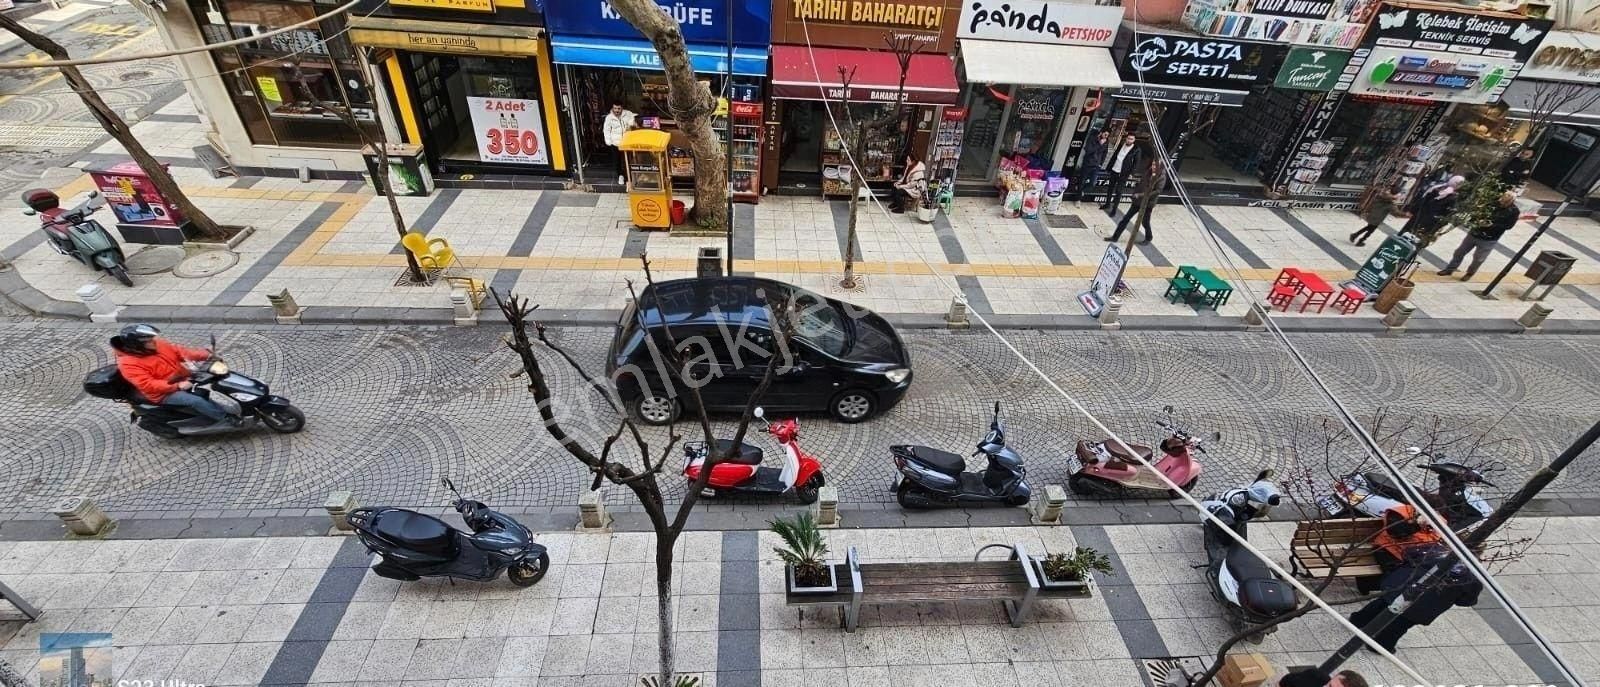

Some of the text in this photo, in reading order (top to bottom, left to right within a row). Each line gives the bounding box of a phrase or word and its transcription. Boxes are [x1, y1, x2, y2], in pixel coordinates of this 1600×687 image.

[852, 2, 942, 29] BAHARATÇI
[970, 2, 1112, 41] panda PETSHOP
[1415, 12, 1463, 30] Kelebek
[1420, 30, 1492, 46] TEKNİK SERVİS
[1172, 40, 1243, 61] PASTA
[485, 100, 526, 111] 2 Adet
[486, 128, 539, 156] 350
